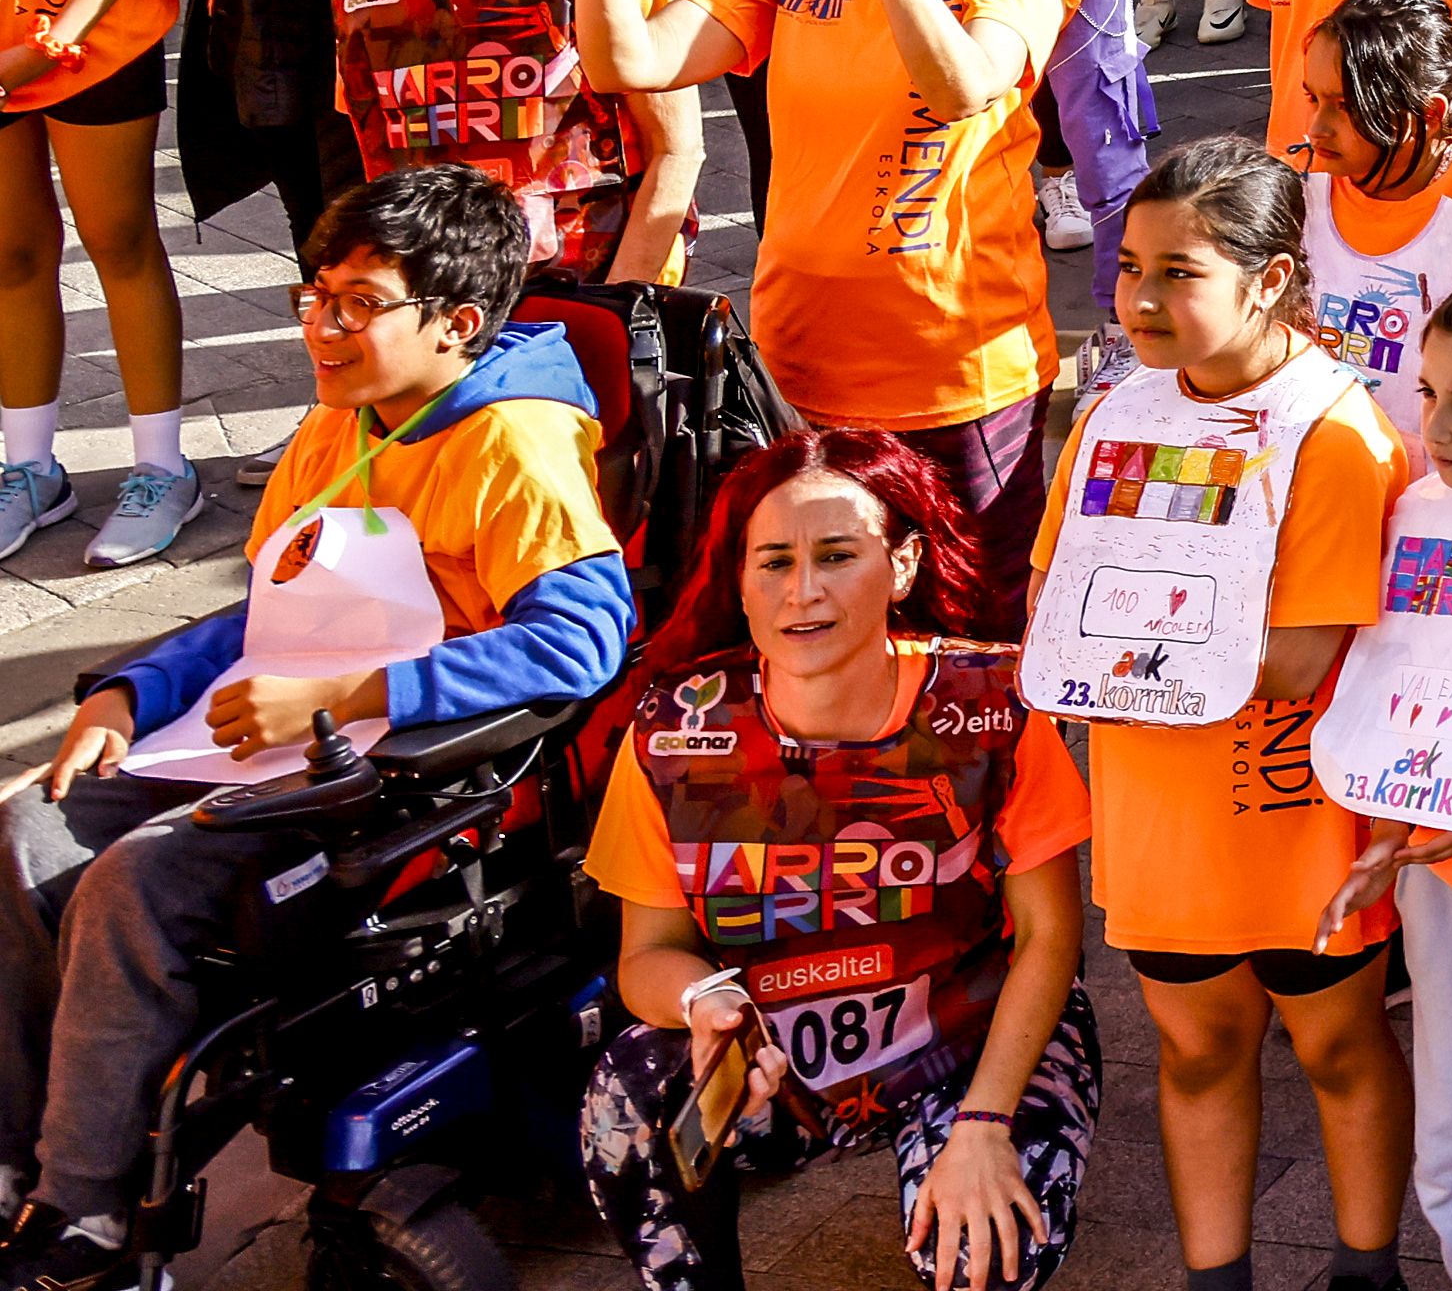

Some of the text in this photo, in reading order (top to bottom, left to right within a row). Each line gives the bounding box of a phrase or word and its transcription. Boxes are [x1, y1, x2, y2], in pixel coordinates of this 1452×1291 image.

[866, 154, 894, 257] ESKOLA
[966, 706, 1014, 734] eitb
[1393, 740, 1443, 780] aek
[759, 952, 882, 993] euskaltel
